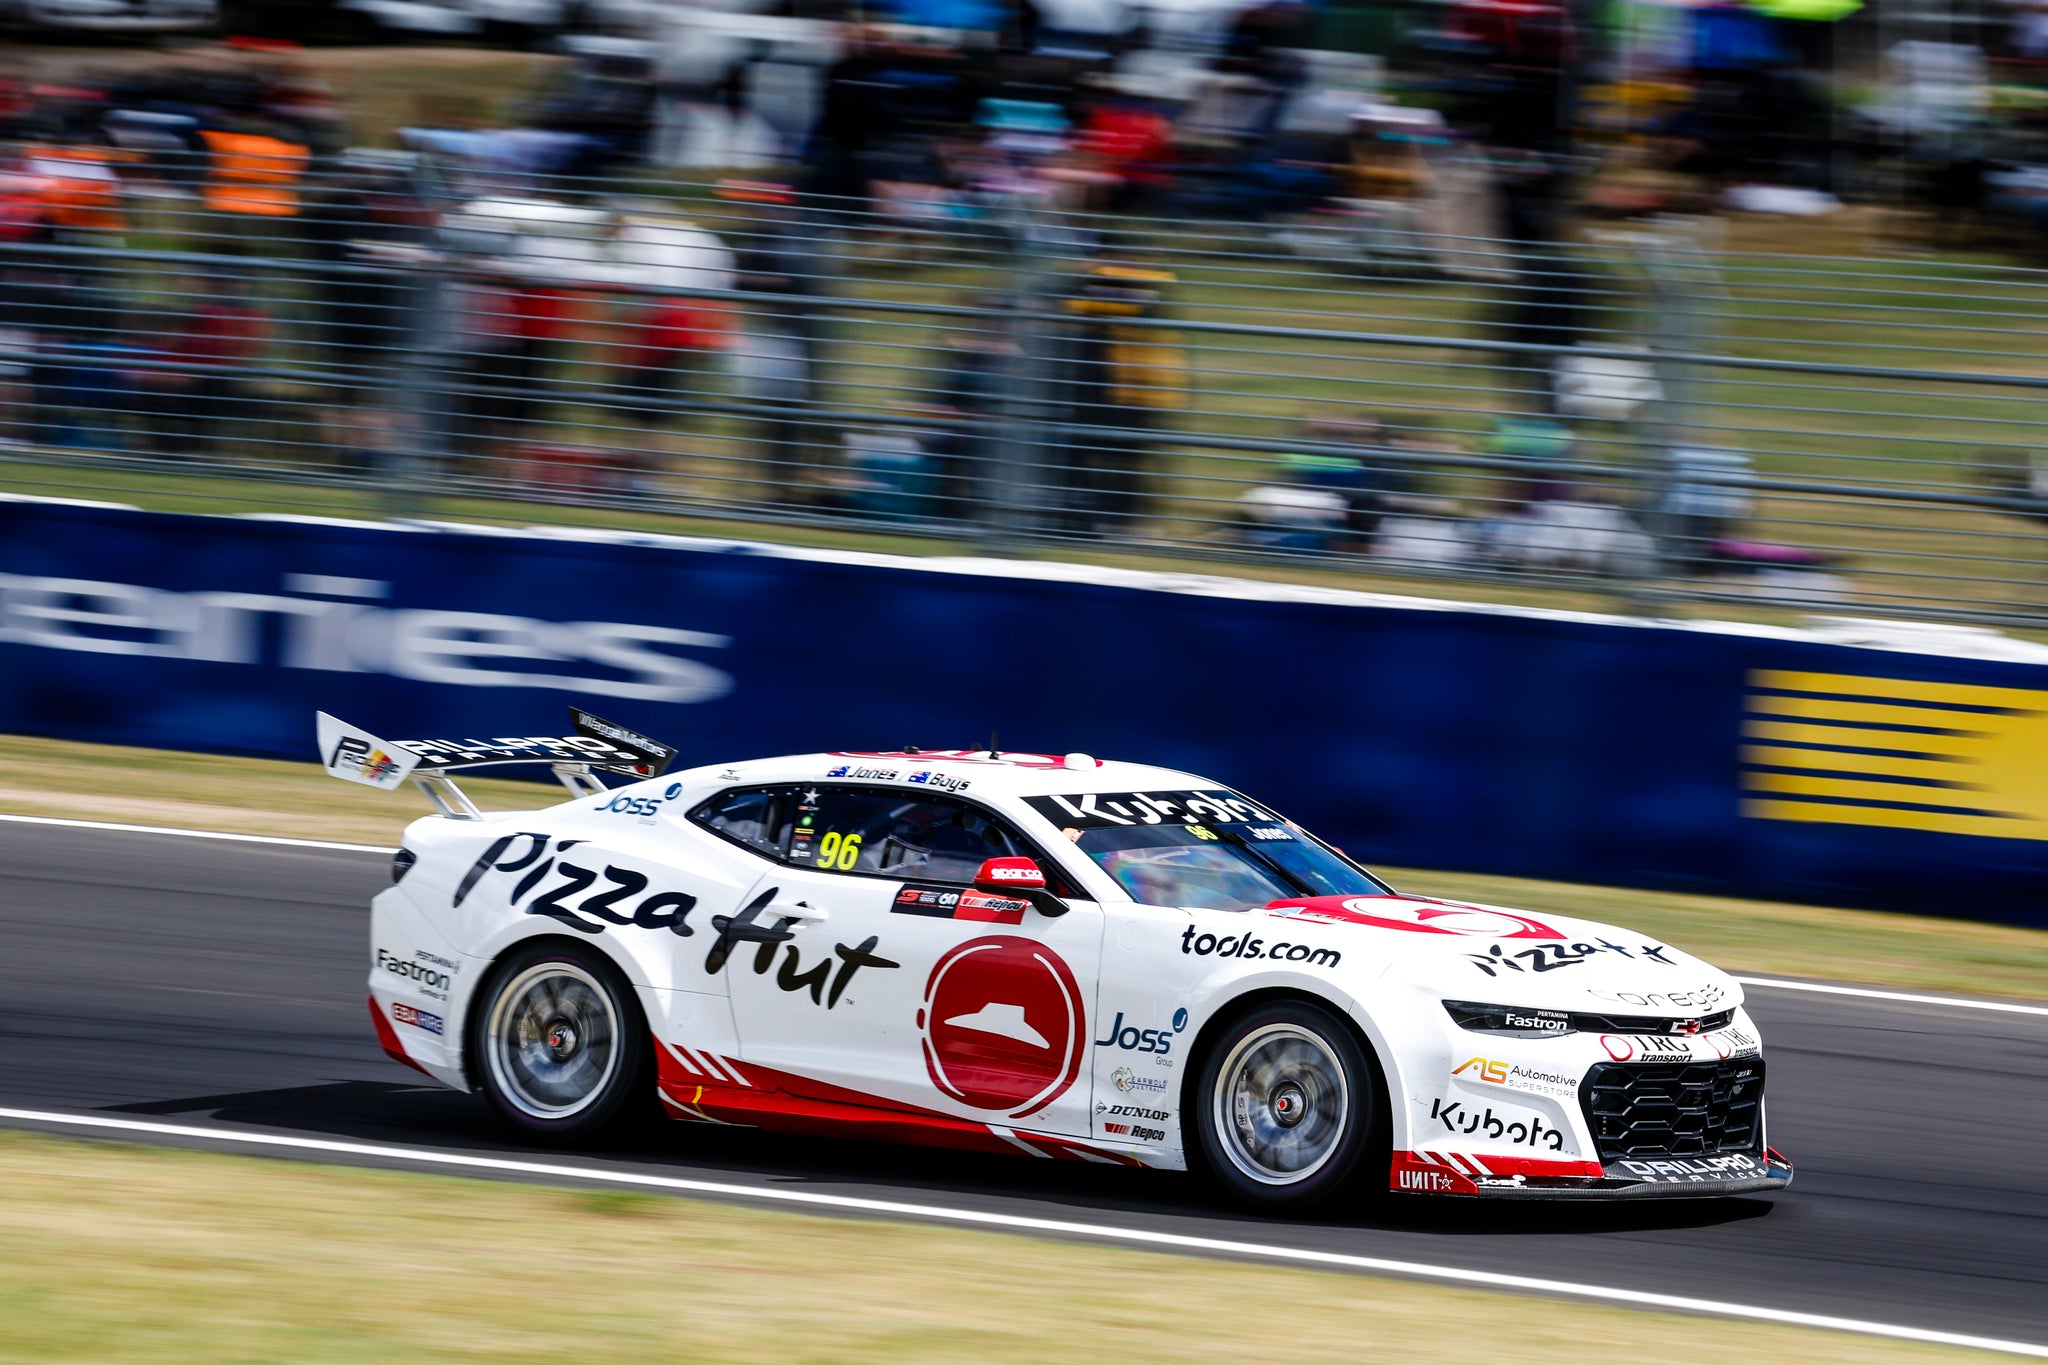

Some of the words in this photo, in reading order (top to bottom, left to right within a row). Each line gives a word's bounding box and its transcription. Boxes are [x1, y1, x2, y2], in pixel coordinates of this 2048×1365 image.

[848, 766, 899, 780] Jones
[929, 773, 971, 792] Boys
[593, 789, 663, 817] Joss
[1049, 791, 1275, 825] Kubota
[1184, 825, 1219, 840] 96
[816, 832, 863, 872] 96
[991, 868, 1043, 880] sparco
[984, 898, 1023, 912] Repco
[453, 832, 698, 938] Pizza
[705, 887, 901, 1010] Hut
[1182, 925, 1341, 967] tools.com
[377, 948, 450, 991] Fastron
[1505, 1013, 1567, 1031] Fastron
[1537, 1010, 1568, 1019] PERTAMINA
[1095, 1012, 1174, 1055] Joss
[1155, 1056, 1173, 1068] Group
[1640, 1052, 1693, 1064] transport
[1510, 1065, 1577, 1087] Automotive
[1508, 1079, 1576, 1099] SUPERSTORE
[1108, 1105, 1169, 1121] DUNLOP
[1131, 1125, 1166, 1141] Repco
[1430, 1097, 1563, 1151] Kubota
[1619, 1153, 1756, 1175] DRILLPRO
[1642, 1168, 1767, 1183] SERVICES
